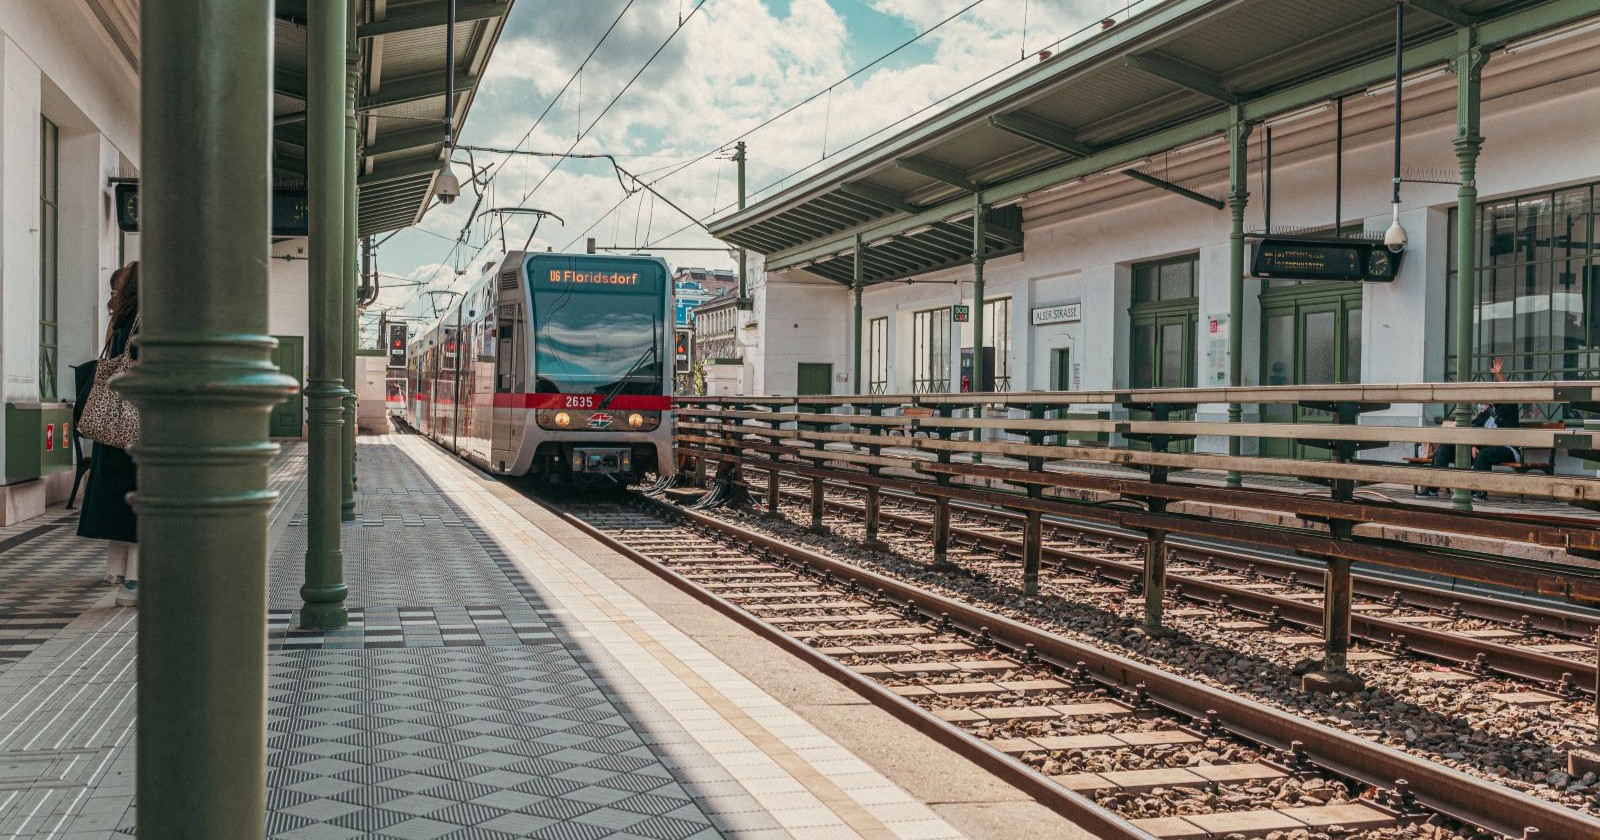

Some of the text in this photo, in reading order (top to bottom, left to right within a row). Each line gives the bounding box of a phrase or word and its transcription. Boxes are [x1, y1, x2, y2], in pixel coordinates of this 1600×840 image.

[550, 270, 638, 285] U6 Floridsdorf
[1035, 307, 1078, 322] ALSER STRASSE
[566, 396, 593, 408] 2635
